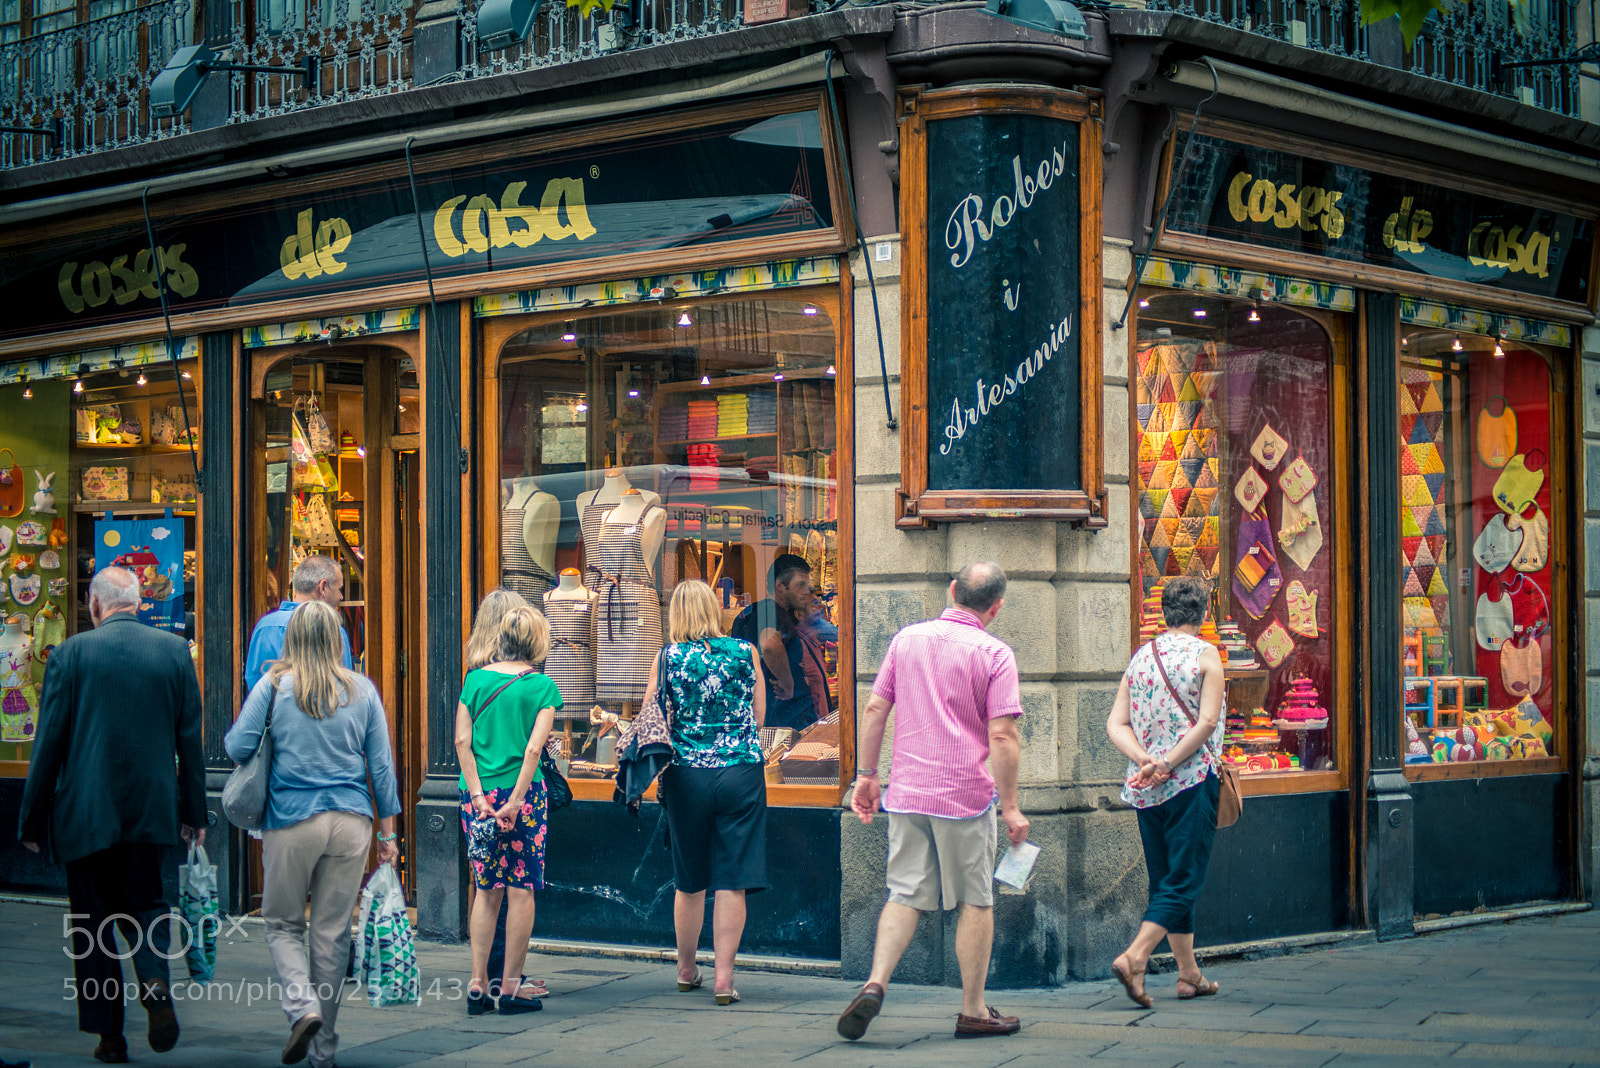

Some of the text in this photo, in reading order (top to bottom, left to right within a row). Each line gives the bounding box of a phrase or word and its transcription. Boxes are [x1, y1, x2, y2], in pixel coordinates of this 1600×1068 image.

[945, 140, 1067, 268] Robes
[1382, 196, 1434, 254] de
[280, 207, 352, 280] de
[1003, 278, 1021, 311] i
[939, 312, 1073, 455] Artesania
